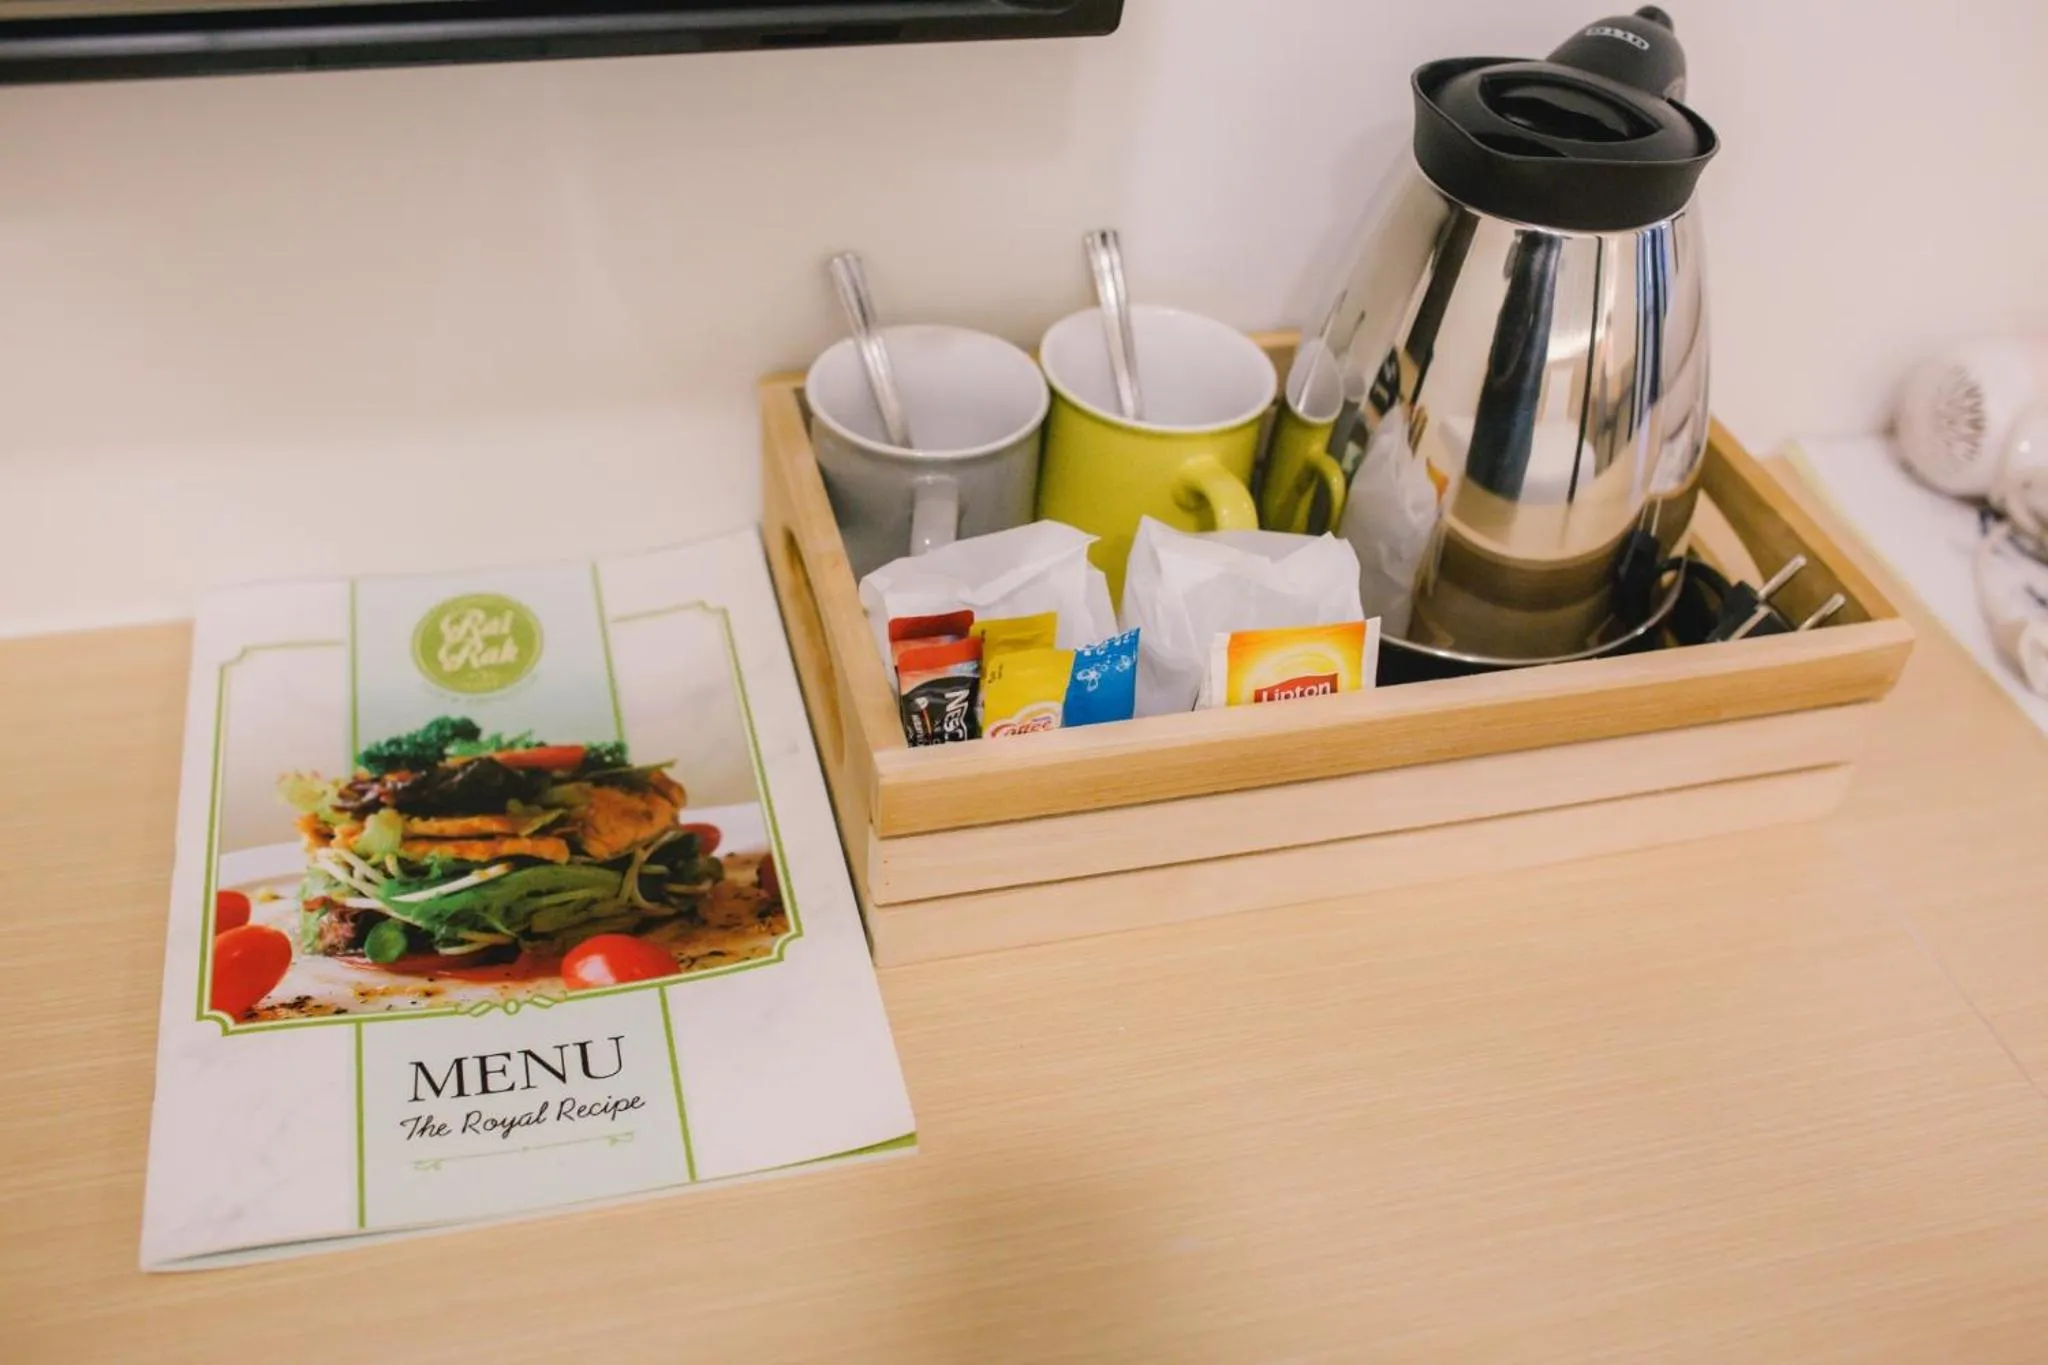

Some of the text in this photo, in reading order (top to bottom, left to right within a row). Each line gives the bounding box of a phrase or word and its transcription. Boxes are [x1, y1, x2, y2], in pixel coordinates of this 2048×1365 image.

[408, 1035, 625, 1102] MENU
[400, 1095, 646, 1140] The Royal Recipe
